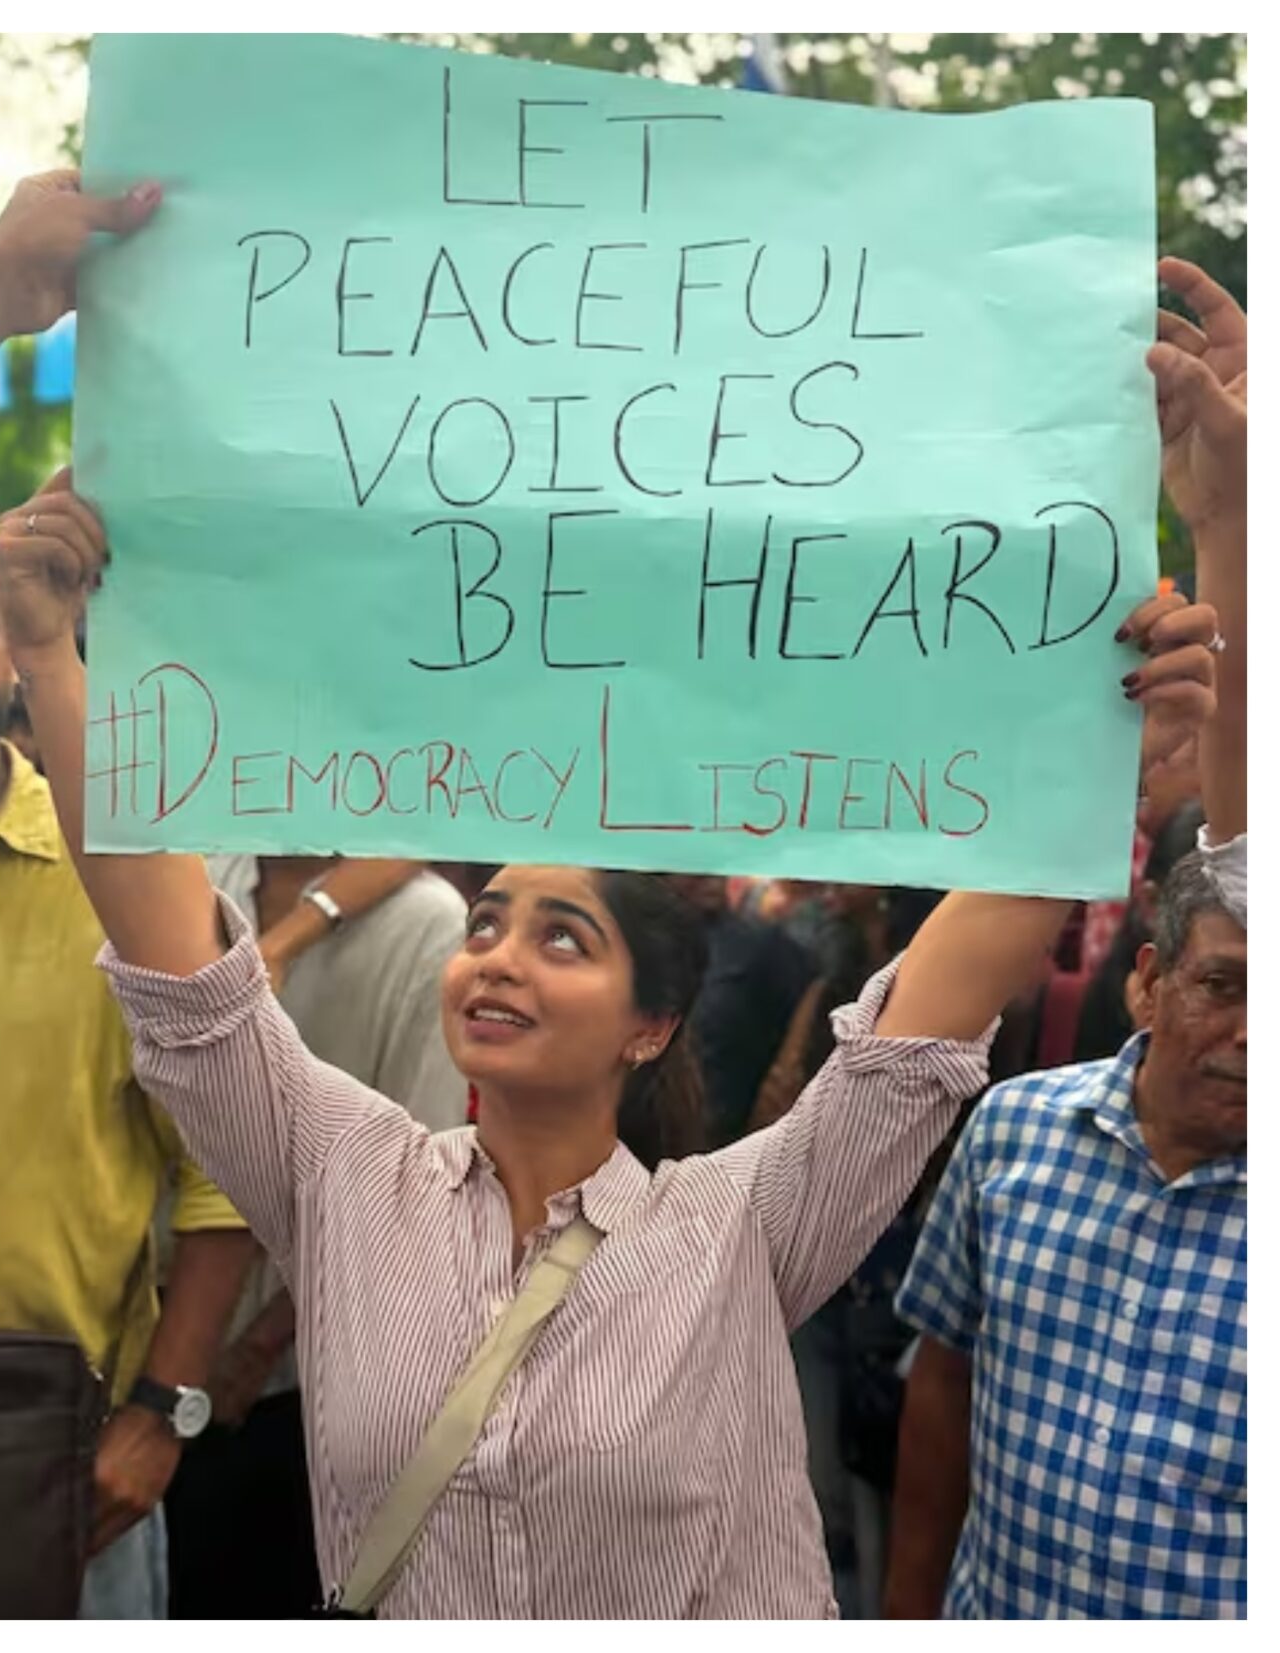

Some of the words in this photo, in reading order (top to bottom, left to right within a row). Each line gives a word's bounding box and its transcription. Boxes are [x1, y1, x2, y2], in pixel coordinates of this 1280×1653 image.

[442, 65, 725, 214] LET
[236, 229, 925, 358] PEACEFUL
[329, 360, 866, 509] VOICES
[408, 509, 627, 672] BE
[695, 500, 1120, 662] HEARD
